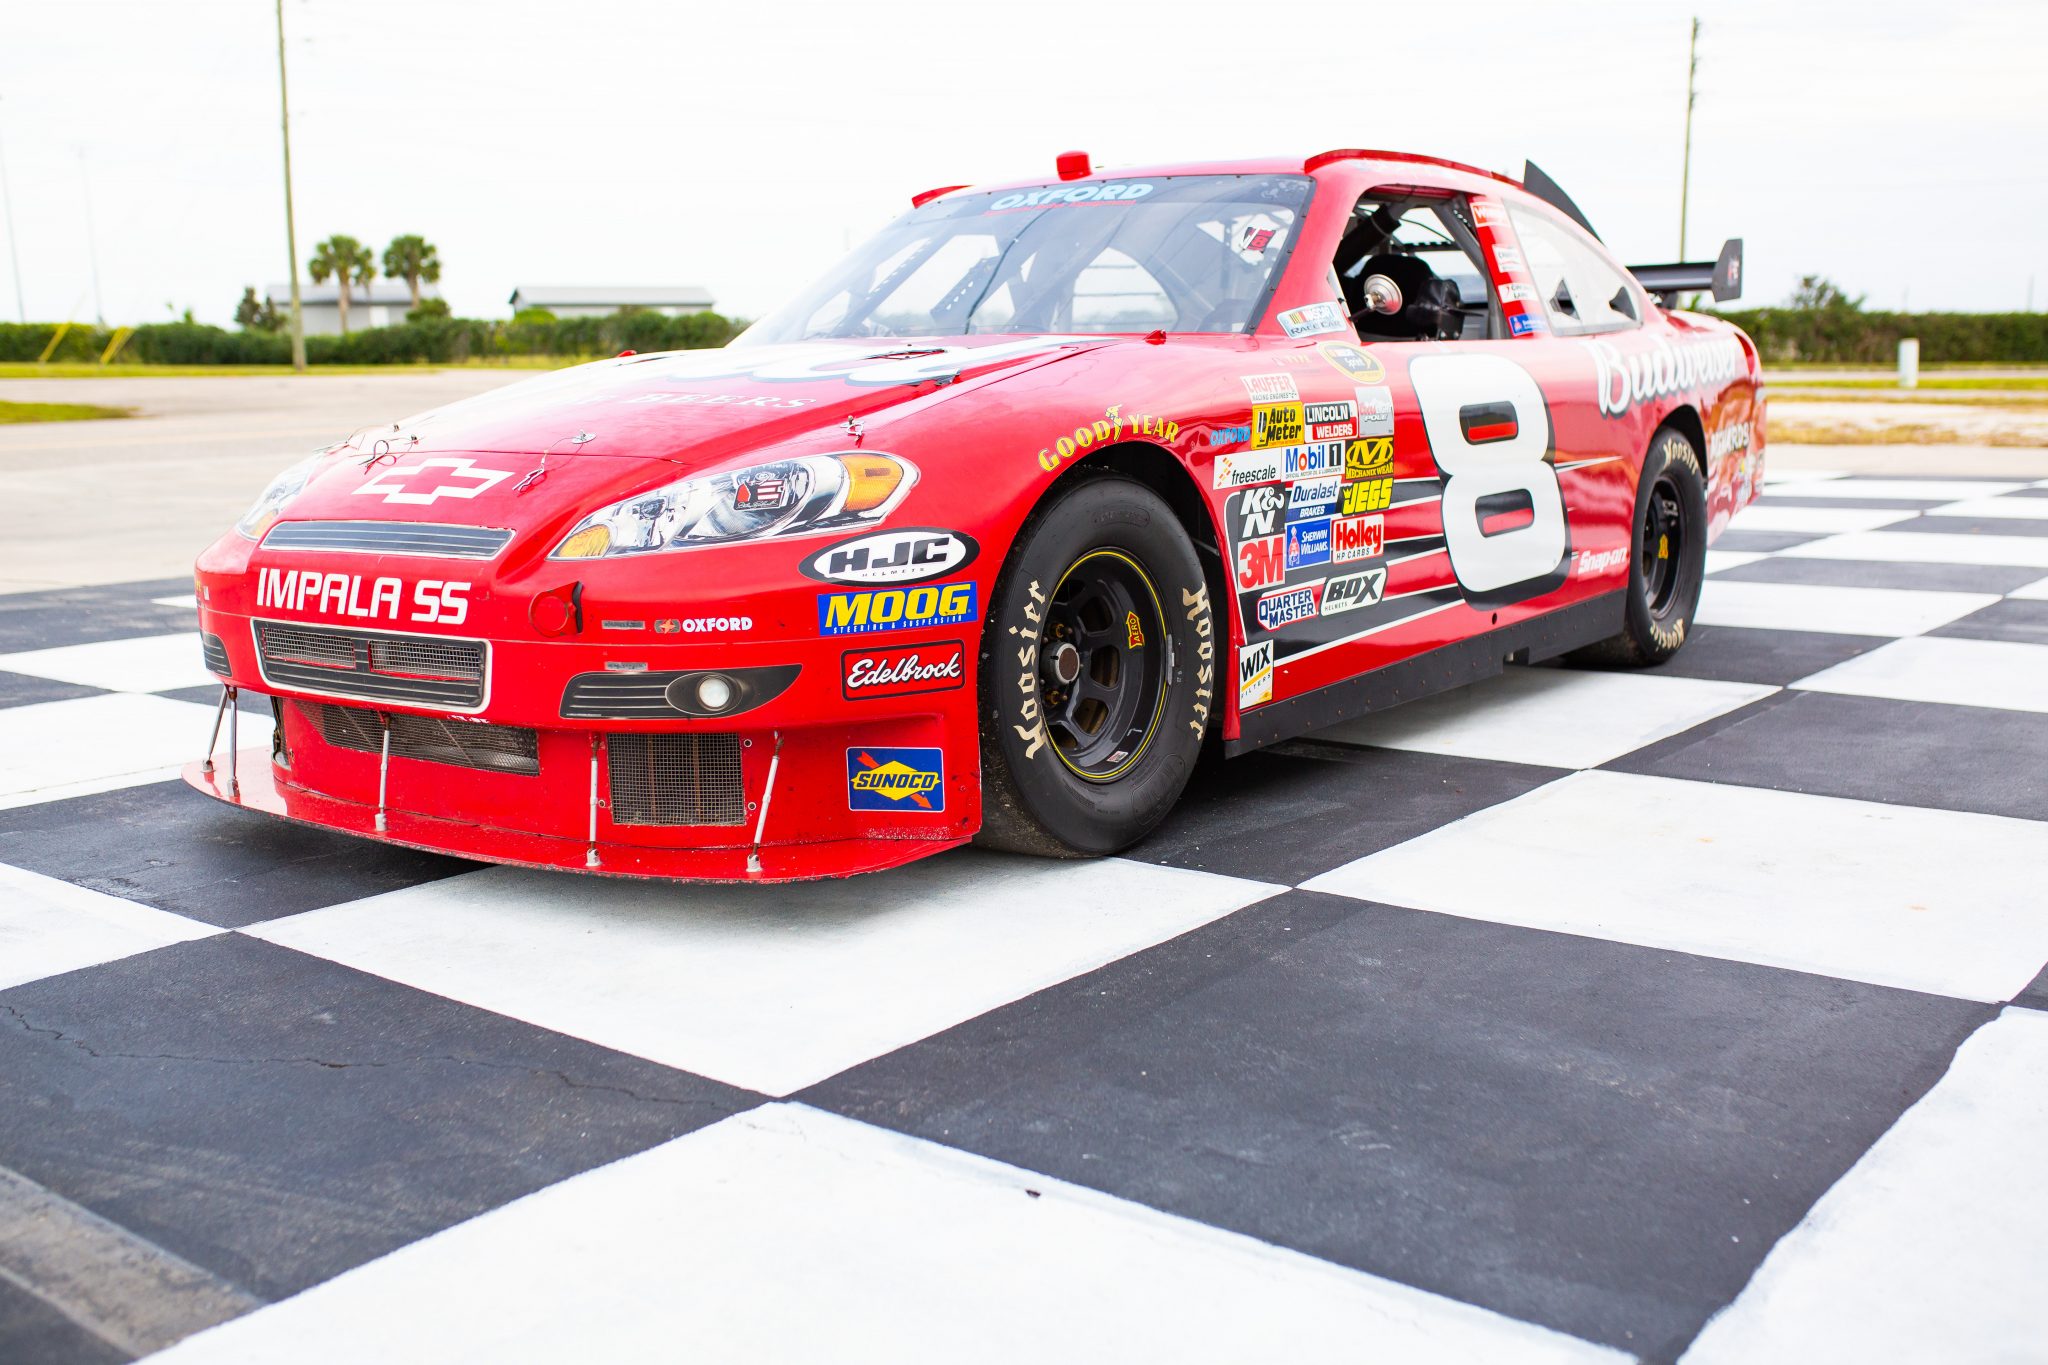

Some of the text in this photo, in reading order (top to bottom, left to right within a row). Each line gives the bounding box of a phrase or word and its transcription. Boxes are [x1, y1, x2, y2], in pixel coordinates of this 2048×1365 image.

[990, 183, 1153, 211] OXFORD
[1243, 376, 1294, 393] LAUFFER
[1269, 407, 1296, 424] Auto
[1306, 404, 1349, 423] LINCOLN
[1038, 413, 1179, 472] GOOD YEAR
[1210, 425, 1251, 446] OXFORD
[1266, 424, 1302, 443] Meter
[1316, 423, 1353, 439] WELDERS
[1285, 443, 1342, 473] Mobil 1
[1231, 465, 1276, 485] freescale
[1346, 467, 1376, 479] MECHANIX
[1410, 353, 1566, 593] 8
[1292, 481, 1337, 502] Duralast
[1342, 477, 1393, 515] JEGS
[1300, 505, 1325, 518] BRAKES
[1301, 529, 1328, 543] SHERWIN
[1336, 519, 1382, 554] Holley
[829, 537, 950, 574] HJC
[1240, 538, 1283, 588] 3M
[1347, 548, 1370, 559] CARBS
[1577, 547, 1628, 574] Snap-on
[257, 567, 472, 626] IMPALA SS
[1326, 573, 1381, 605] BOX
[825, 583, 971, 628] MOOG
[1259, 590, 1311, 620] QUARTER
[1269, 602, 1314, 628] MASTER
[682, 617, 753, 633] OXFORD
[833, 623, 883, 634] STEERING
[903, 614, 962, 627] SUSPENSION
[1129, 618, 1141, 642] AERO
[847, 653, 961, 688] Edelbrock
[1008, 579, 1047, 760] Hoosier
[1182, 581, 1212, 741] Hoosier
[1241, 643, 1270, 682] WIX
[1241, 673, 1270, 698] FILTERS
[856, 773, 936, 789] SUNOCO
